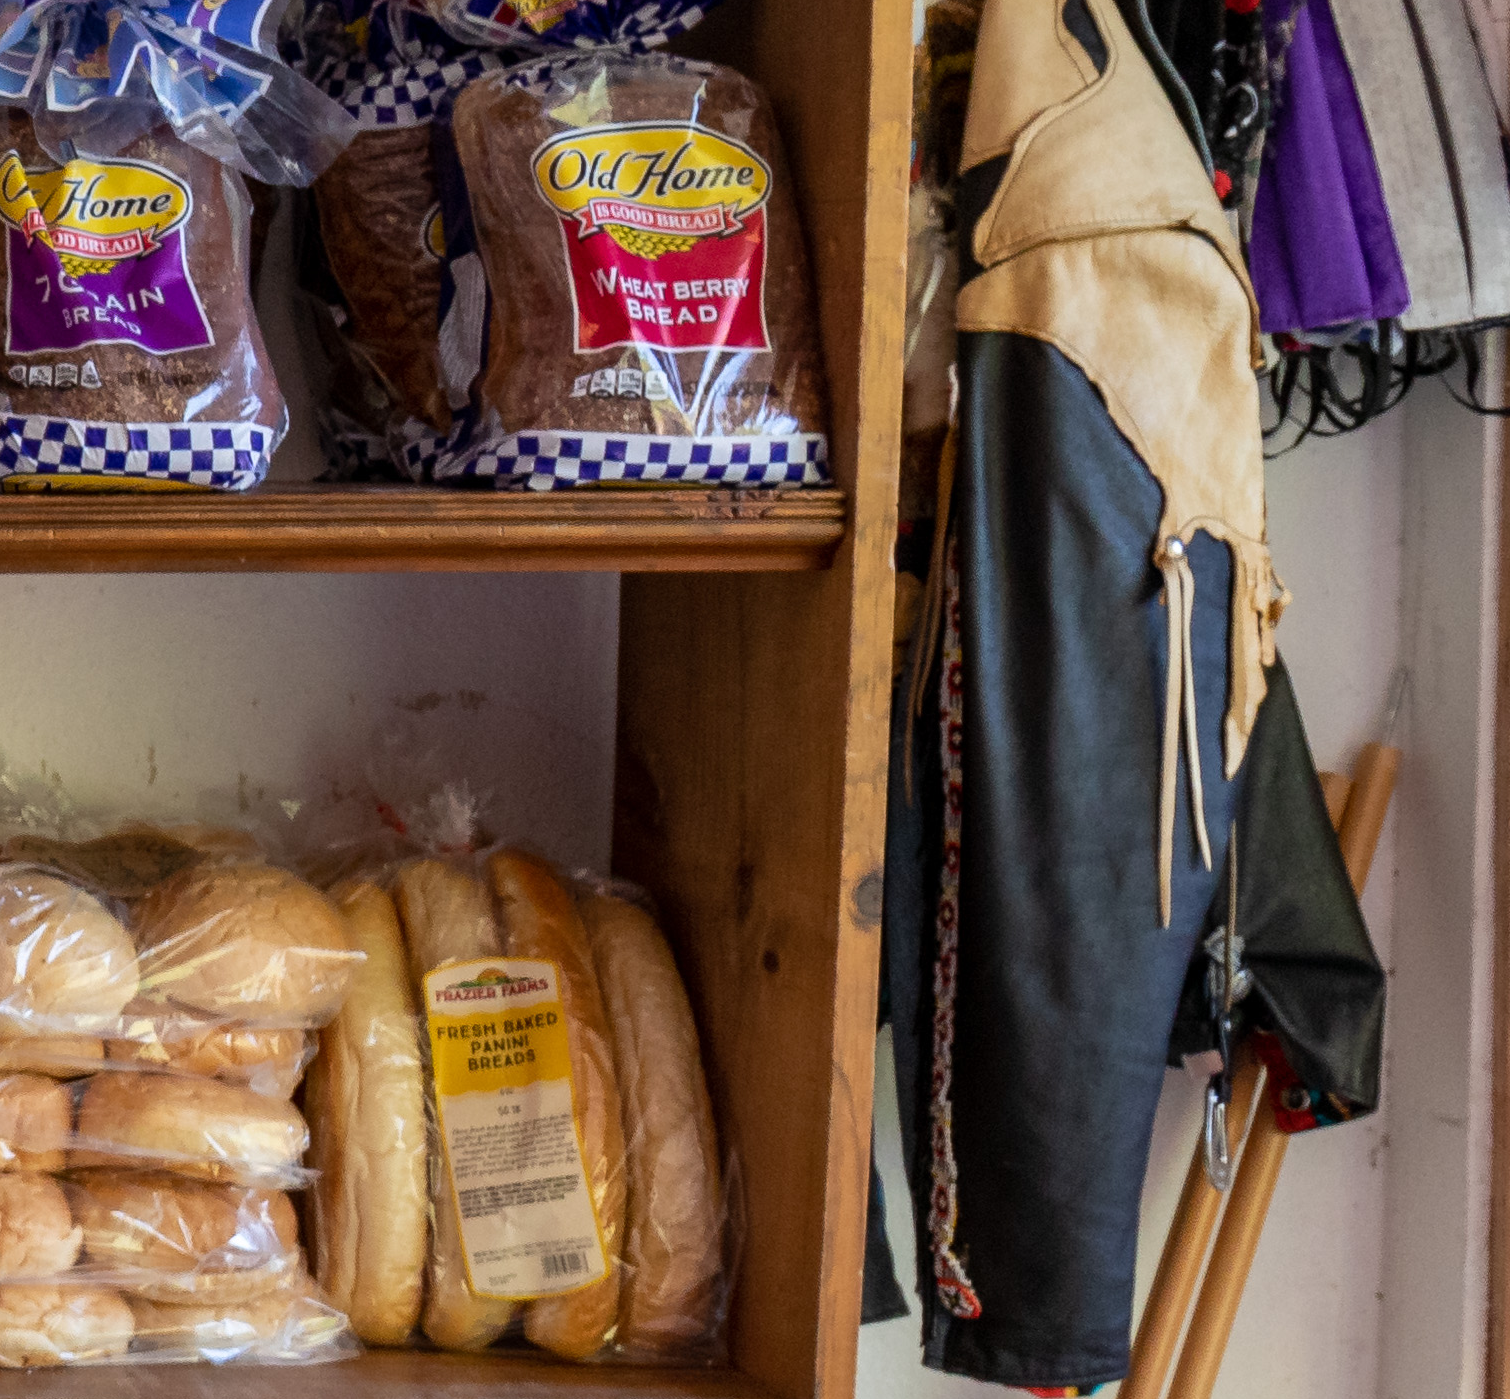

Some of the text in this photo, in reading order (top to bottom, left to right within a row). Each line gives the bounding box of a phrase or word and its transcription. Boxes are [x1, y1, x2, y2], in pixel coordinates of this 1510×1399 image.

[548, 143, 755, 198] Old Home
[60, 164, 172, 227] Home
[657, 209, 719, 229] BREAD
[77, 233, 138, 252] BREAD
[673, 276, 750, 300] BERRY
[627, 300, 719, 325] BREAD
[435, 978, 549, 1002] FRAZIER FARMS
[437, 1012, 558, 1040] FRESH BAKED
[471, 1036, 529, 1054] PANINI
[468, 1049, 536, 1071] BREADS
